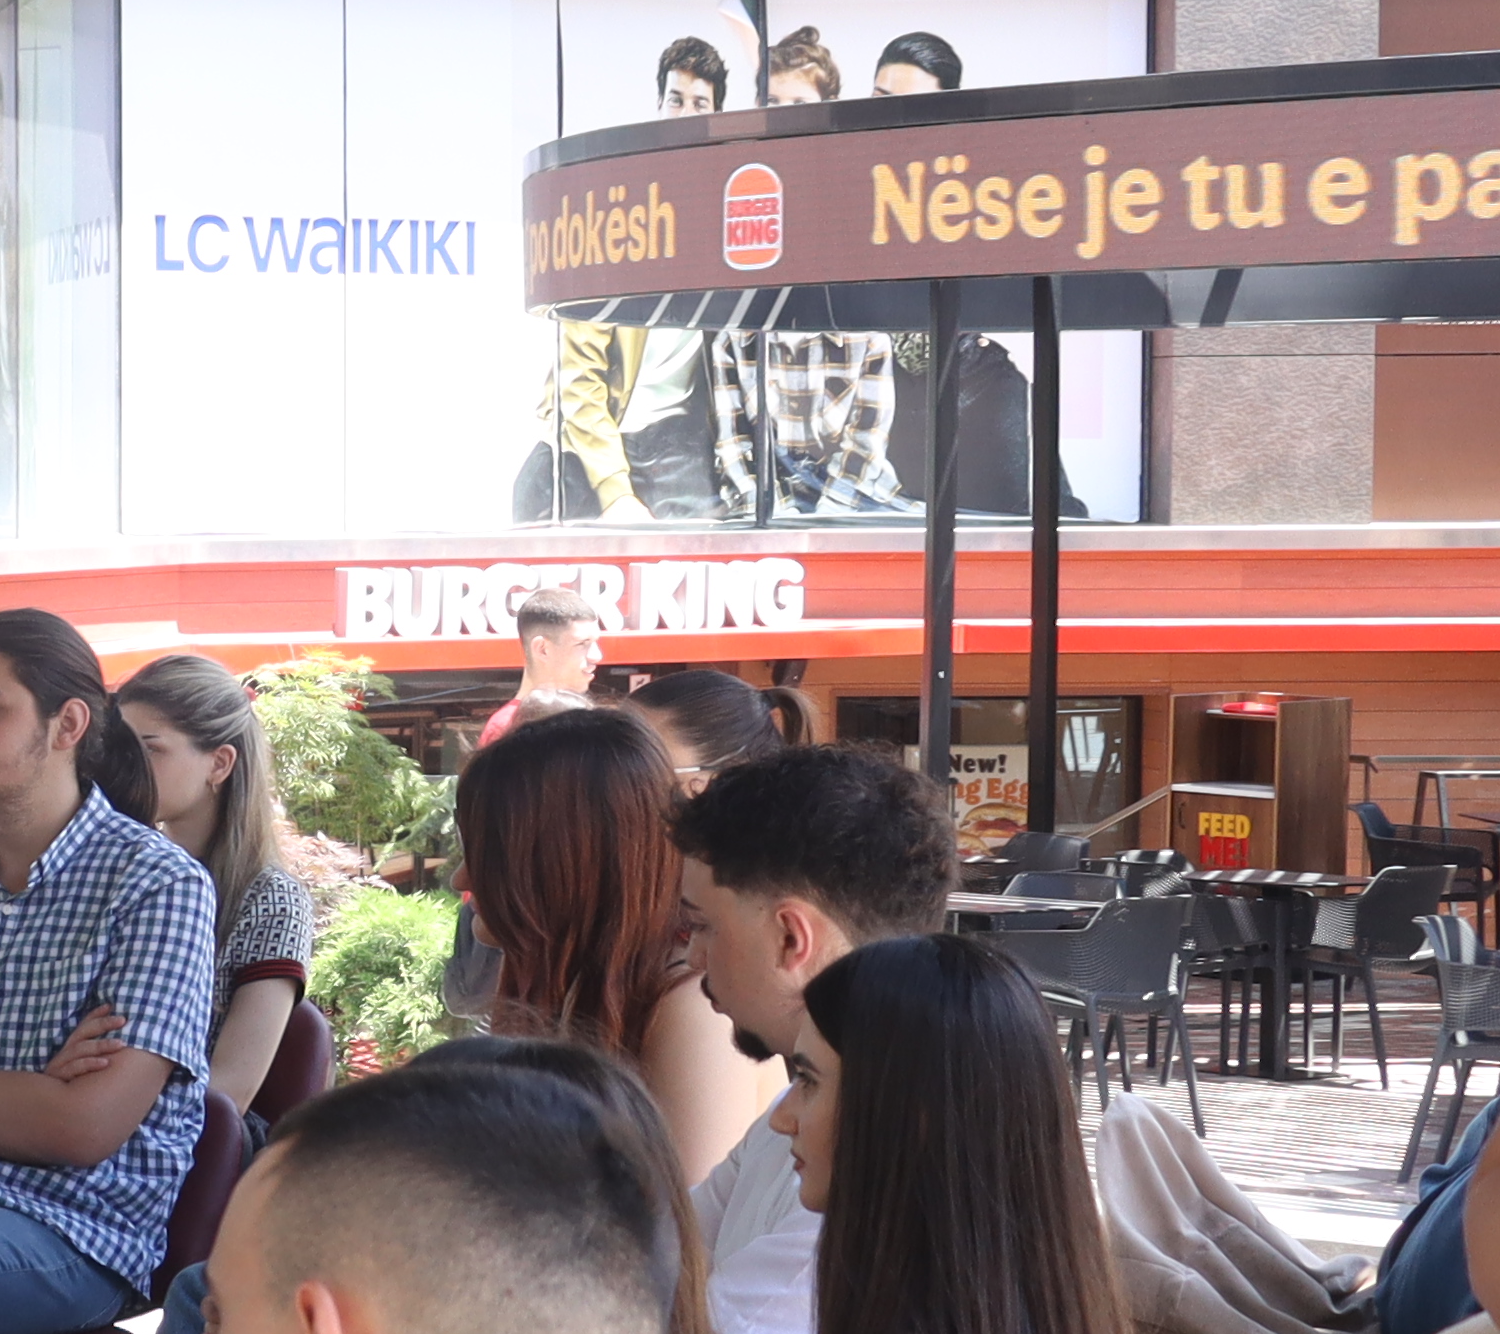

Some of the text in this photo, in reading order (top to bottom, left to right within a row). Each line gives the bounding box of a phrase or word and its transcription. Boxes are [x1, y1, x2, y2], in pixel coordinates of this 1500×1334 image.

[552, 182, 676, 271] dokësh
[871, 154, 1067, 245] Nëse
[1076, 145, 1165, 260] je
[1181, 155, 1286, 231] tu
[1307, 157, 1372, 226] e
[154, 213, 229, 273] LC
[727, 218, 780, 247] KING
[334, 557, 805, 638] BURGER KING
[1198, 812, 1252, 839] FEED
[1200, 836, 1250, 867] ME!
